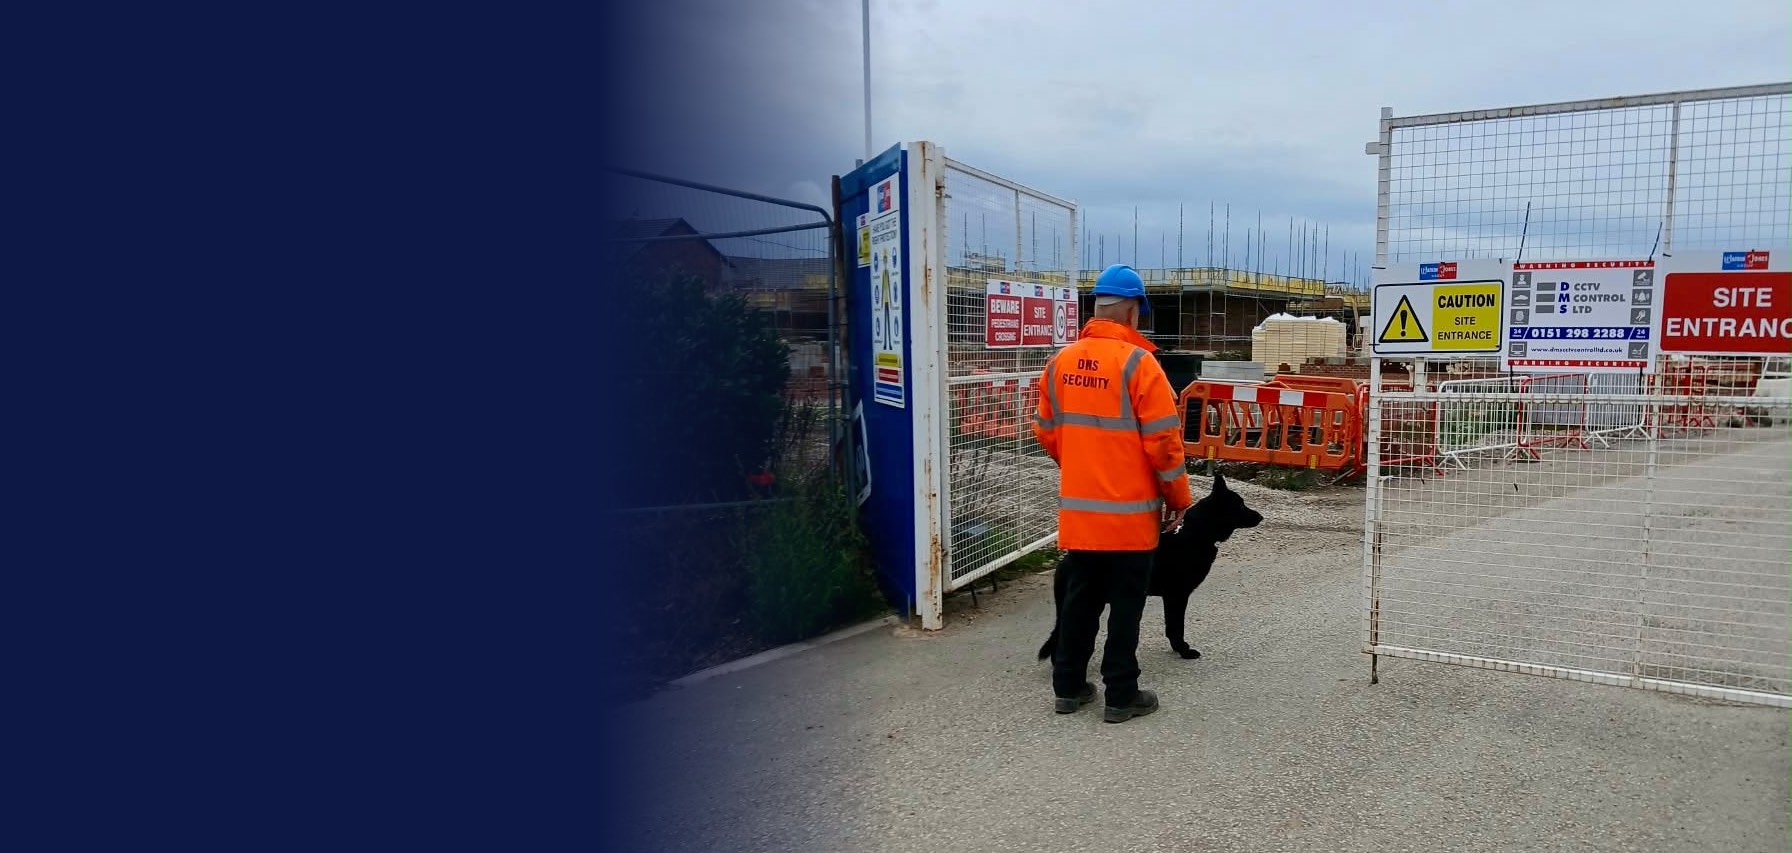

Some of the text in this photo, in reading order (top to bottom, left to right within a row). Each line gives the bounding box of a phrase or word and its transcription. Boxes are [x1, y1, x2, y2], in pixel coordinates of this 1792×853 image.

[1561, 282, 1600, 291] D CCTV
[1437, 294, 1495, 308] CAUTION
[1558, 293, 1626, 302] M CONTROL
[1713, 287, 1773, 307] SITE
[991, 299, 1019, 314] BEWARE
[1560, 304, 1592, 313] S LTD
[1034, 307, 1046, 319] SITE
[1454, 316, 1476, 326] SITE
[1023, 324, 1053, 336] ENTRANCE
[1437, 330, 1492, 340] ENTRANCE
[1531, 328, 1560, 338] 0151
[1566, 328, 1589, 338] 298
[1593, 328, 1625, 338] 2288
